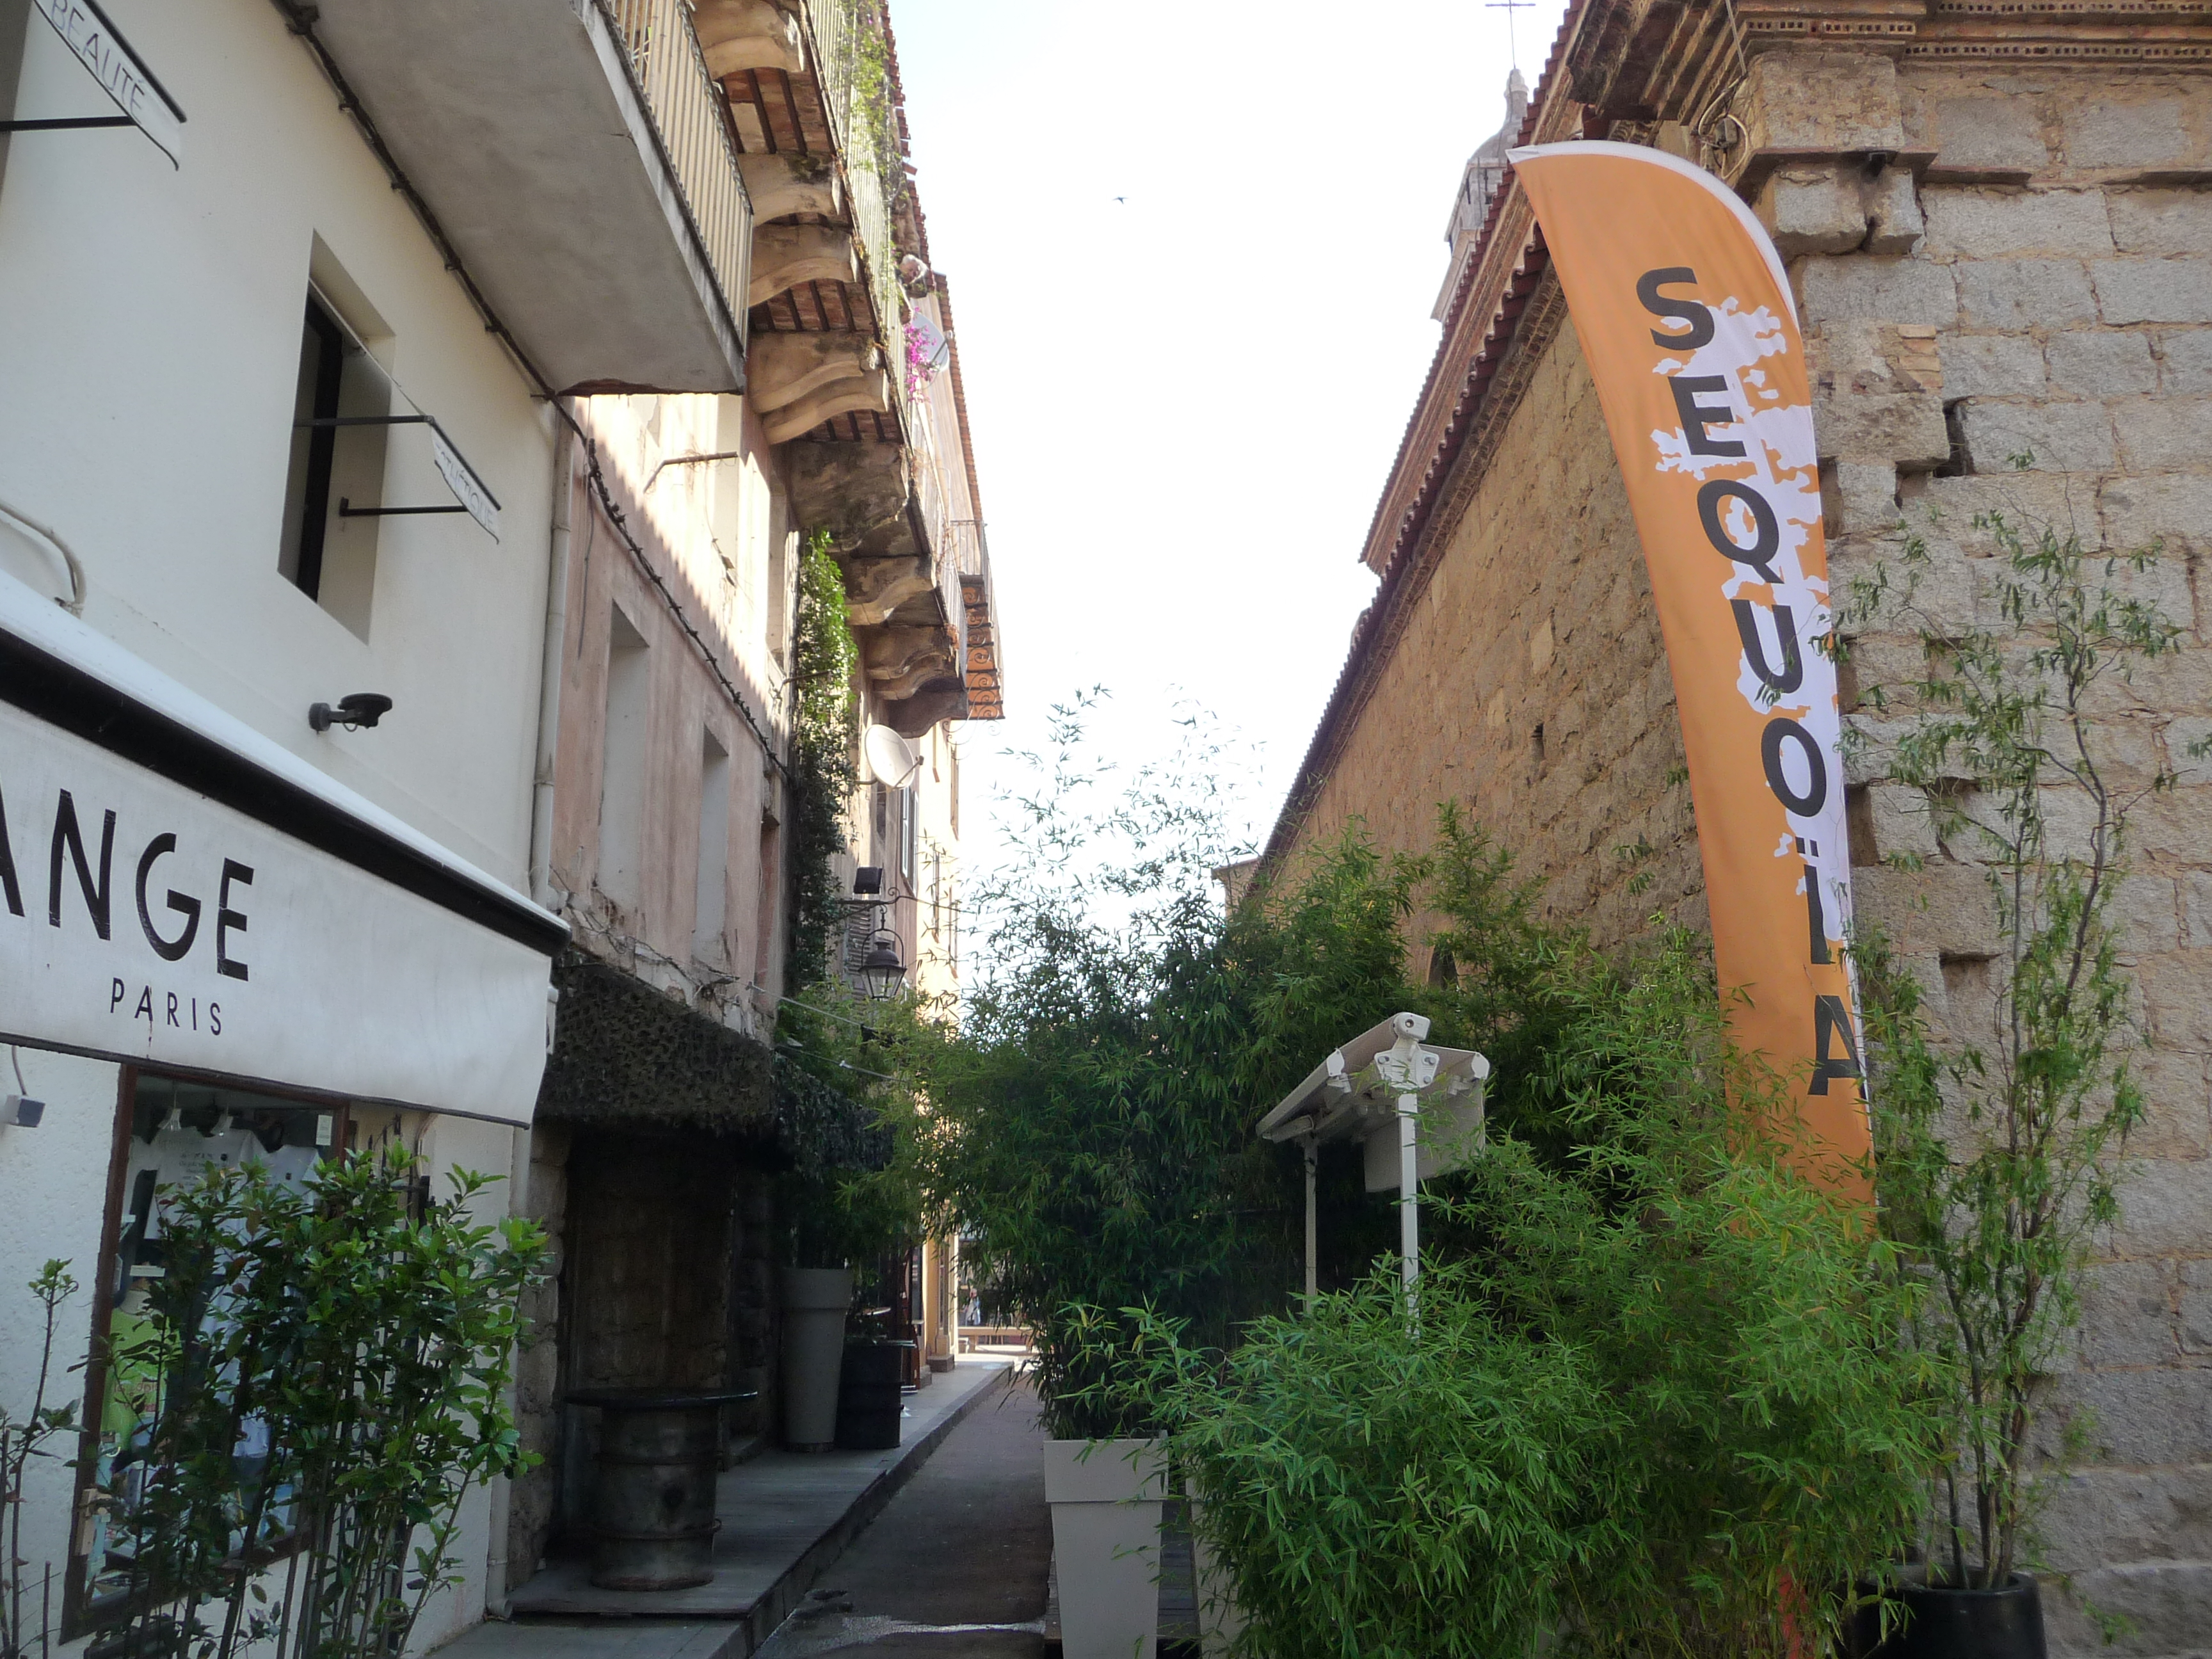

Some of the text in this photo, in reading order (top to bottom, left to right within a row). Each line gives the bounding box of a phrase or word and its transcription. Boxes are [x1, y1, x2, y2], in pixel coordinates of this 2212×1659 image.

[51, 0, 145, 124] BEAUTÉ
[1636, 266, 1868, 1100] SEQUOÏA
[110, 977, 221, 1036] PARIS
